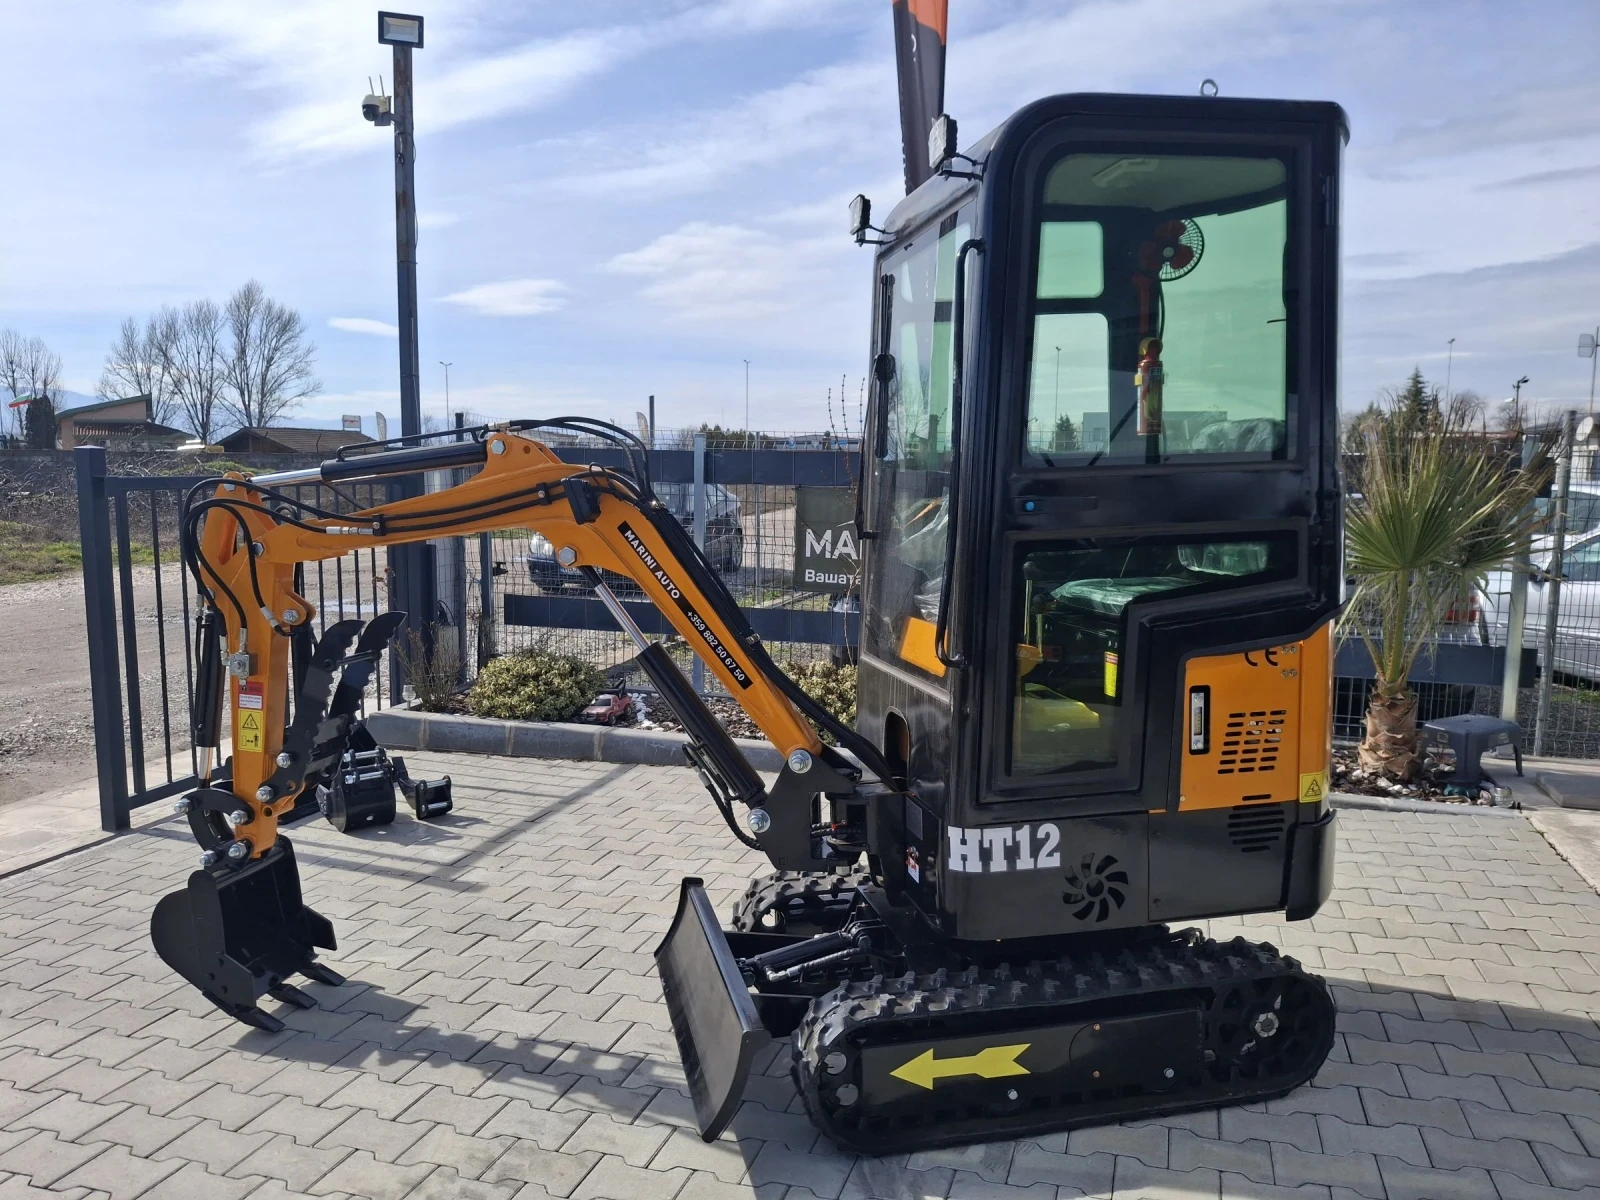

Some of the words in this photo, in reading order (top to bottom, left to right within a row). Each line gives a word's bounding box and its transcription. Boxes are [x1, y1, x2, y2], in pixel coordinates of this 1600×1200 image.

[805, 528, 863, 560] MA
[625, 530, 657, 569] MARINI
[655, 570, 680, 599] AUTO
[687, 611, 706, 631] +359
[703, 630, 718, 648] 882
[715, 646, 727, 658] 50
[724, 657, 737, 669] 67
[733, 668, 745, 681] 50
[947, 823, 1061, 873] HT12
